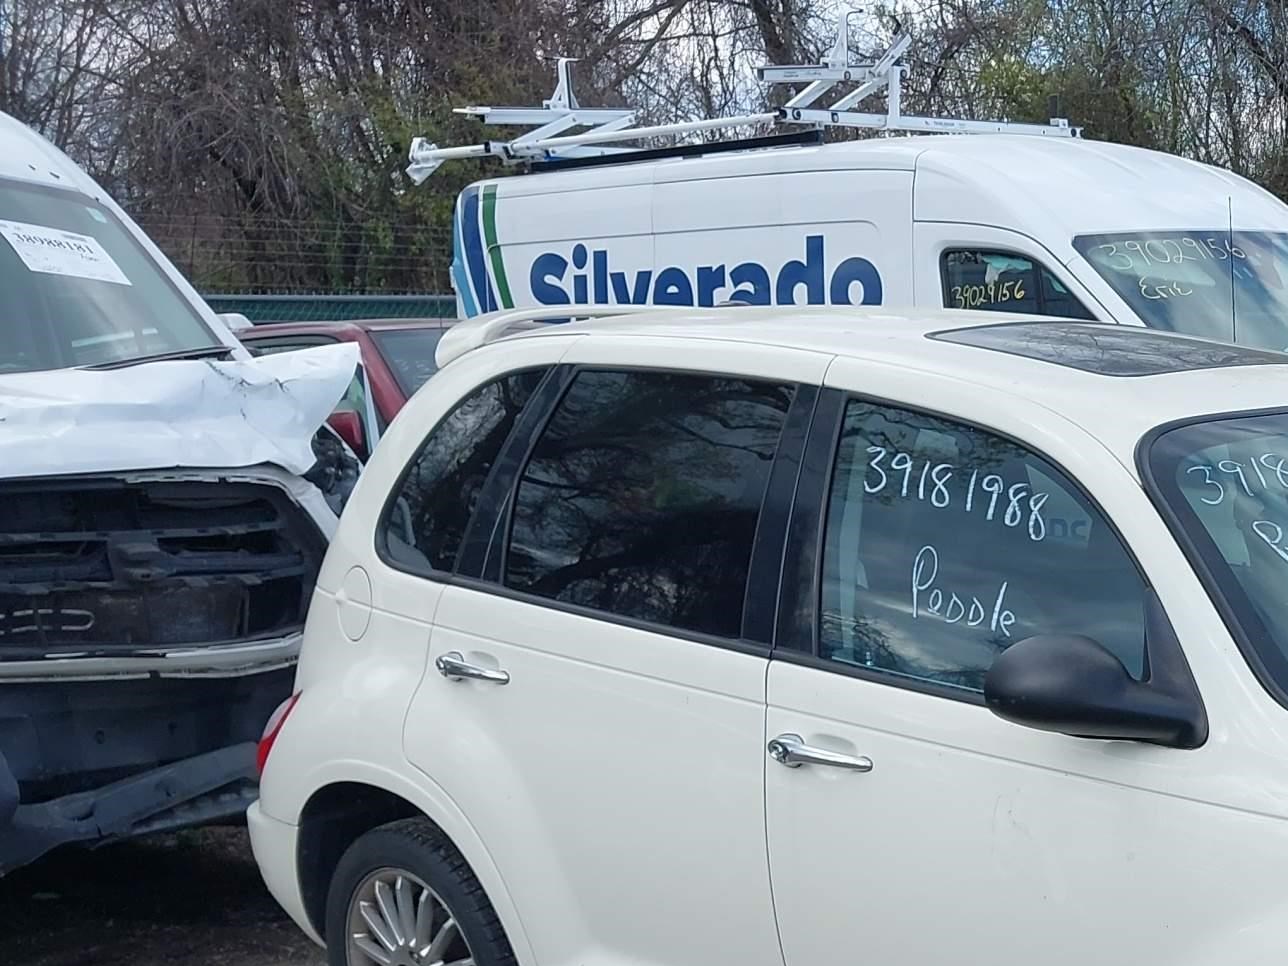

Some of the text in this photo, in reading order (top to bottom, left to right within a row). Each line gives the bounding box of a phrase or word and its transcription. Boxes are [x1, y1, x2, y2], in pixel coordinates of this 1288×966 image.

[530, 235, 883, 322] Silverado
[1098, 237, 1245, 270] 39029156
[951, 279, 1025, 309] 39029156
[864, 445, 1049, 541] 39181988
